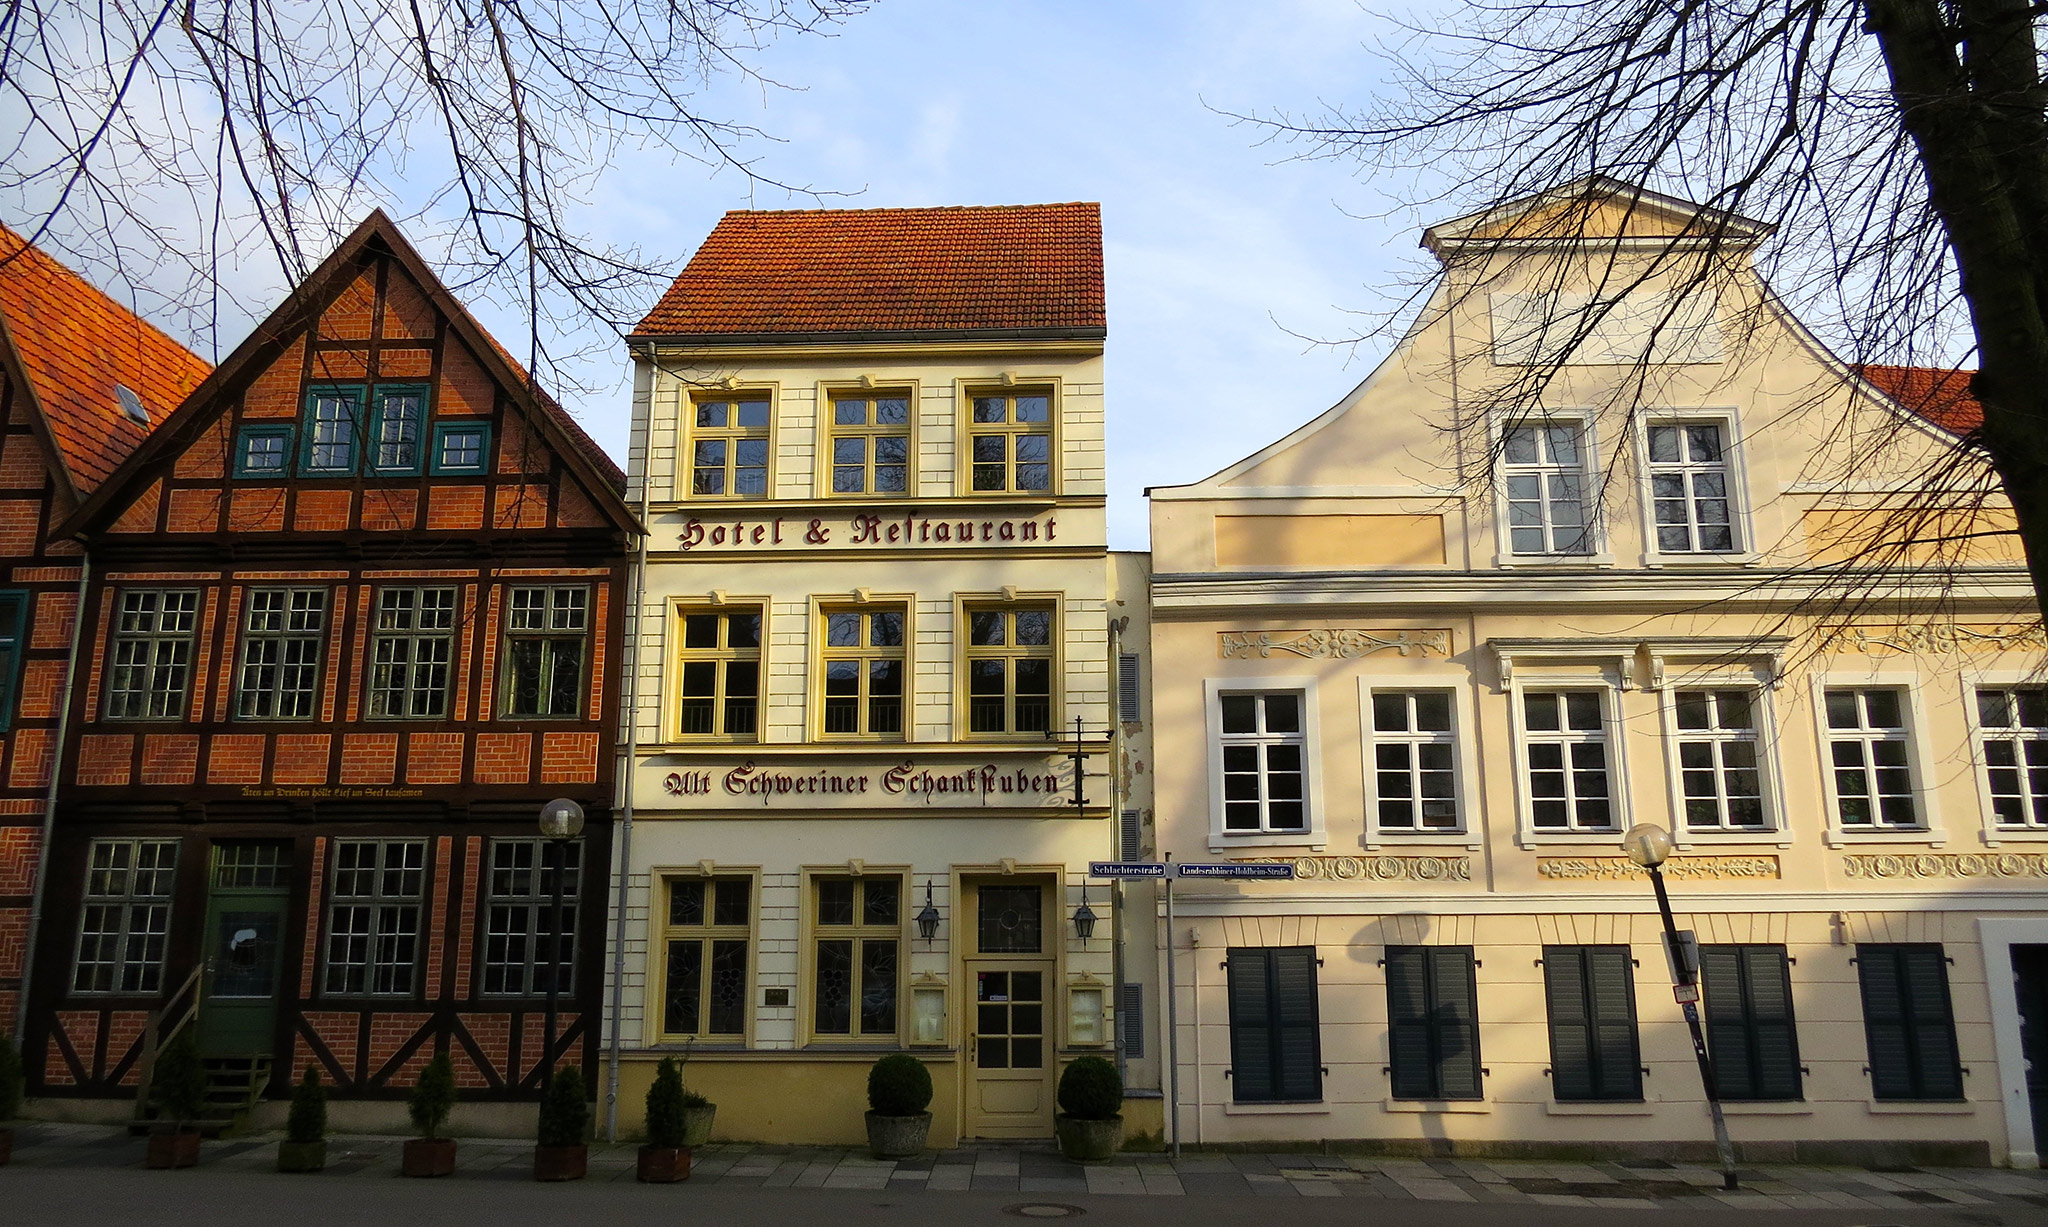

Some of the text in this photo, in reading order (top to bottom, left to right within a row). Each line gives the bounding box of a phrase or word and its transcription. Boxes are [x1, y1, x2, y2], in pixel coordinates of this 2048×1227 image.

[679, 510, 1058, 550] Hotel & Restaurant
[666, 768, 711, 796] Alt
[725, 760, 869, 806] Schweriner
[1094, 865, 1163, 875] Schlachterstraße
[1182, 866, 1289, 876] Landesrabbiner-Holdheim-Straße
